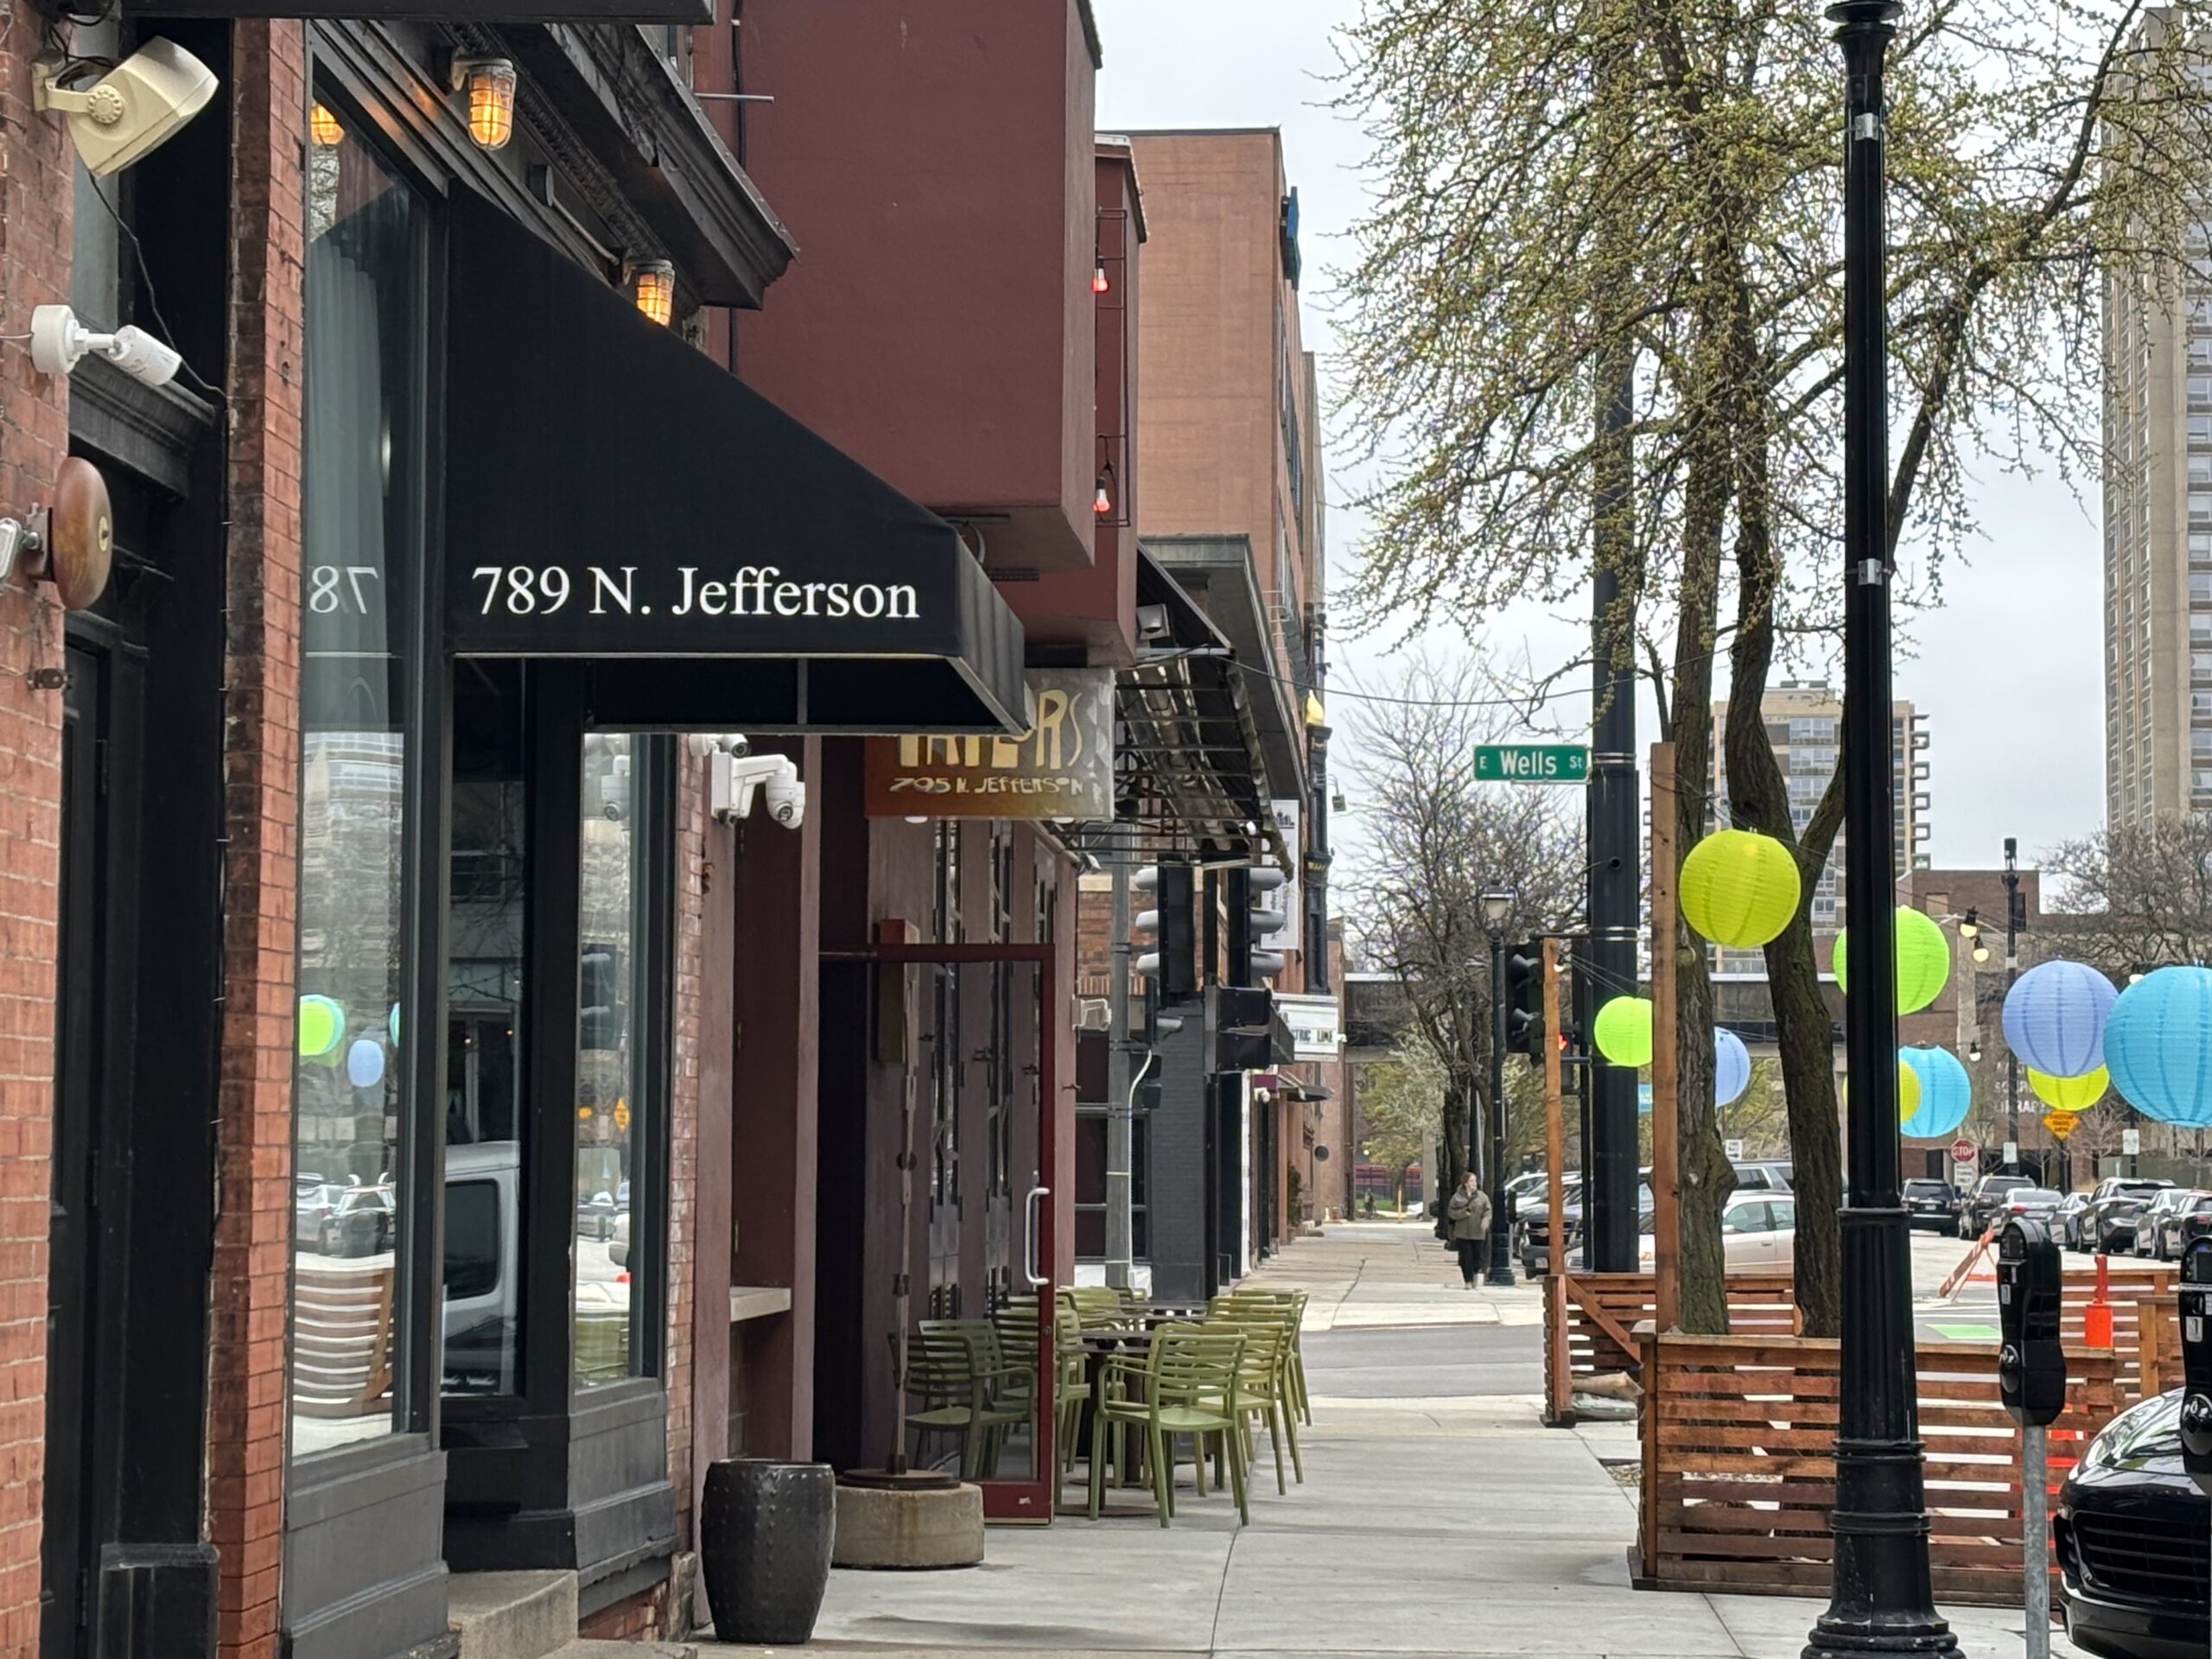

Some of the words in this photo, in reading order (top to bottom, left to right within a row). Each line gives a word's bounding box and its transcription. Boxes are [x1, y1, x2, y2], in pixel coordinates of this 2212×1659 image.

[472, 566, 570, 615] 789
[588, 566, 651, 616] N.
[671, 566, 920, 620] Jefferson
[1478, 755, 1488, 770] E
[1499, 749, 1558, 776] Wells
[1568, 754, 1583, 770] St
[1952, 1146, 1975, 1157] STOP
